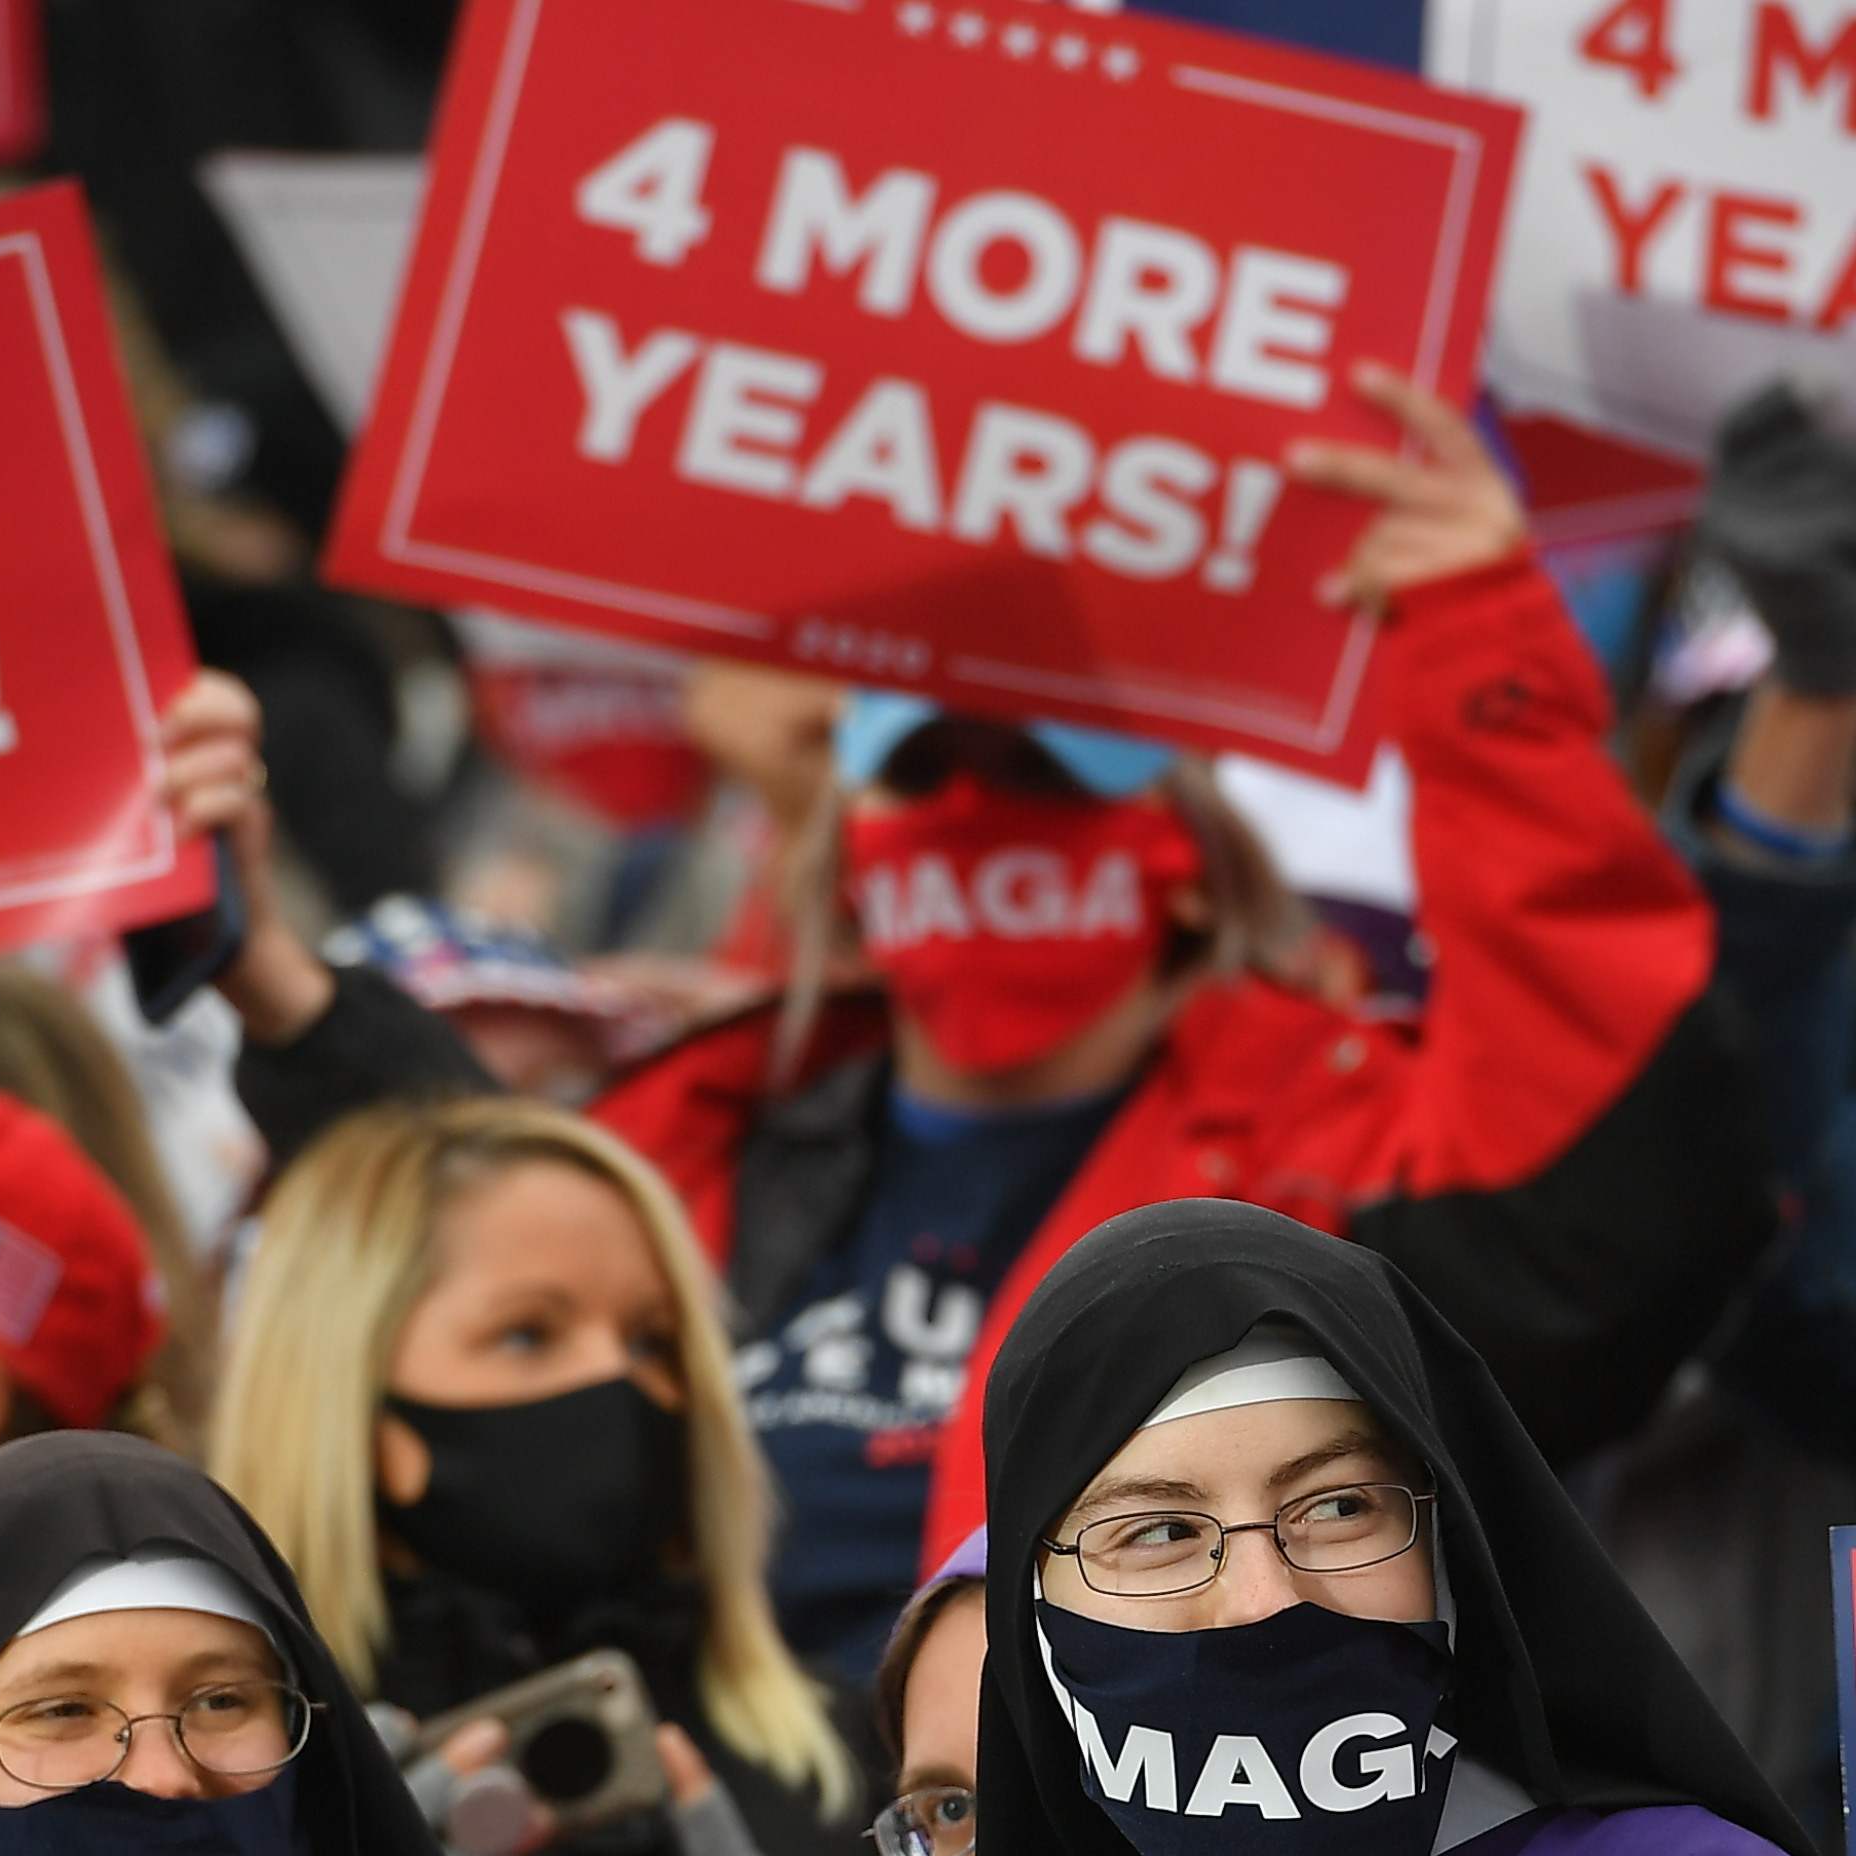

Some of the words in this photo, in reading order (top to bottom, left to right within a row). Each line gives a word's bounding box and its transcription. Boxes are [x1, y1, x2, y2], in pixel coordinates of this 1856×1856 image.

[1572, 0, 1680, 101] 4
[575, 115, 717, 267] 4
[755, 144, 1351, 410] MORE
[558, 308, 1287, 595] YEARS!
